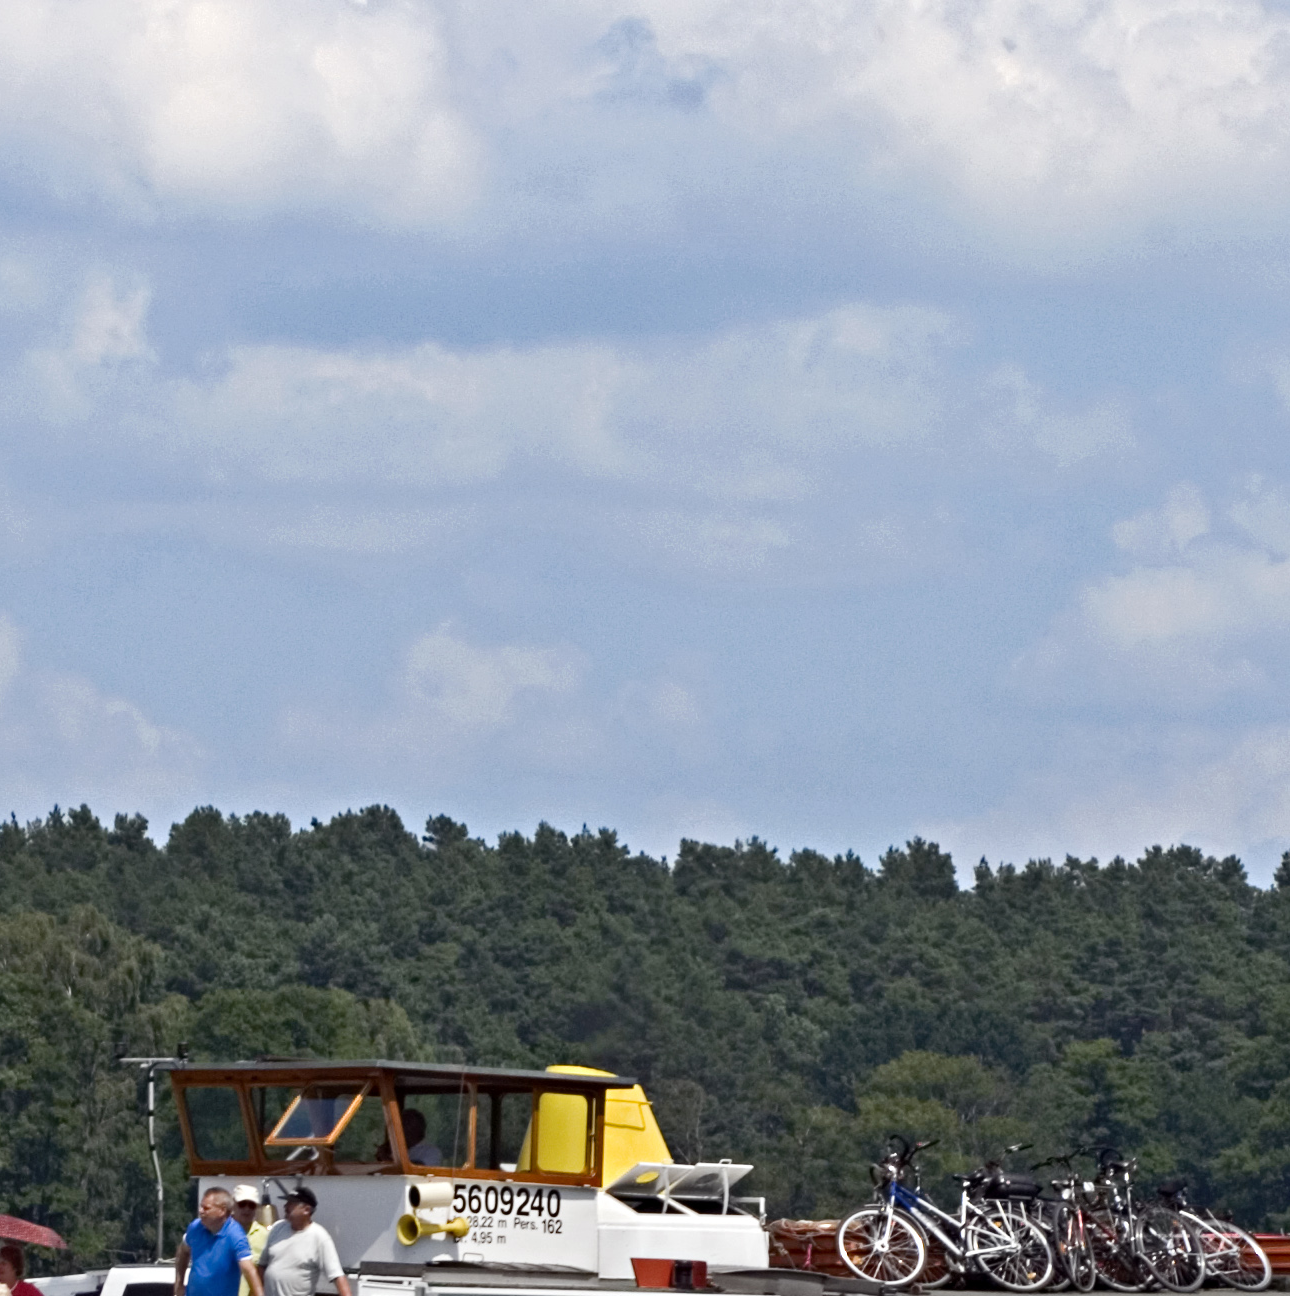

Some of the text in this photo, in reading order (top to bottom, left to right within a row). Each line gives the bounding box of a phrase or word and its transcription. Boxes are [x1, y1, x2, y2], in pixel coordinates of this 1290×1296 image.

[453, 1184, 561, 1218] 5609240
[497, 1219, 507, 1229] m
[513, 1216, 538, 1231] Pers.
[541, 1218, 562, 1234] 162
[470, 1231, 493, 1245] 4,95
[497, 1234, 506, 1244] m
